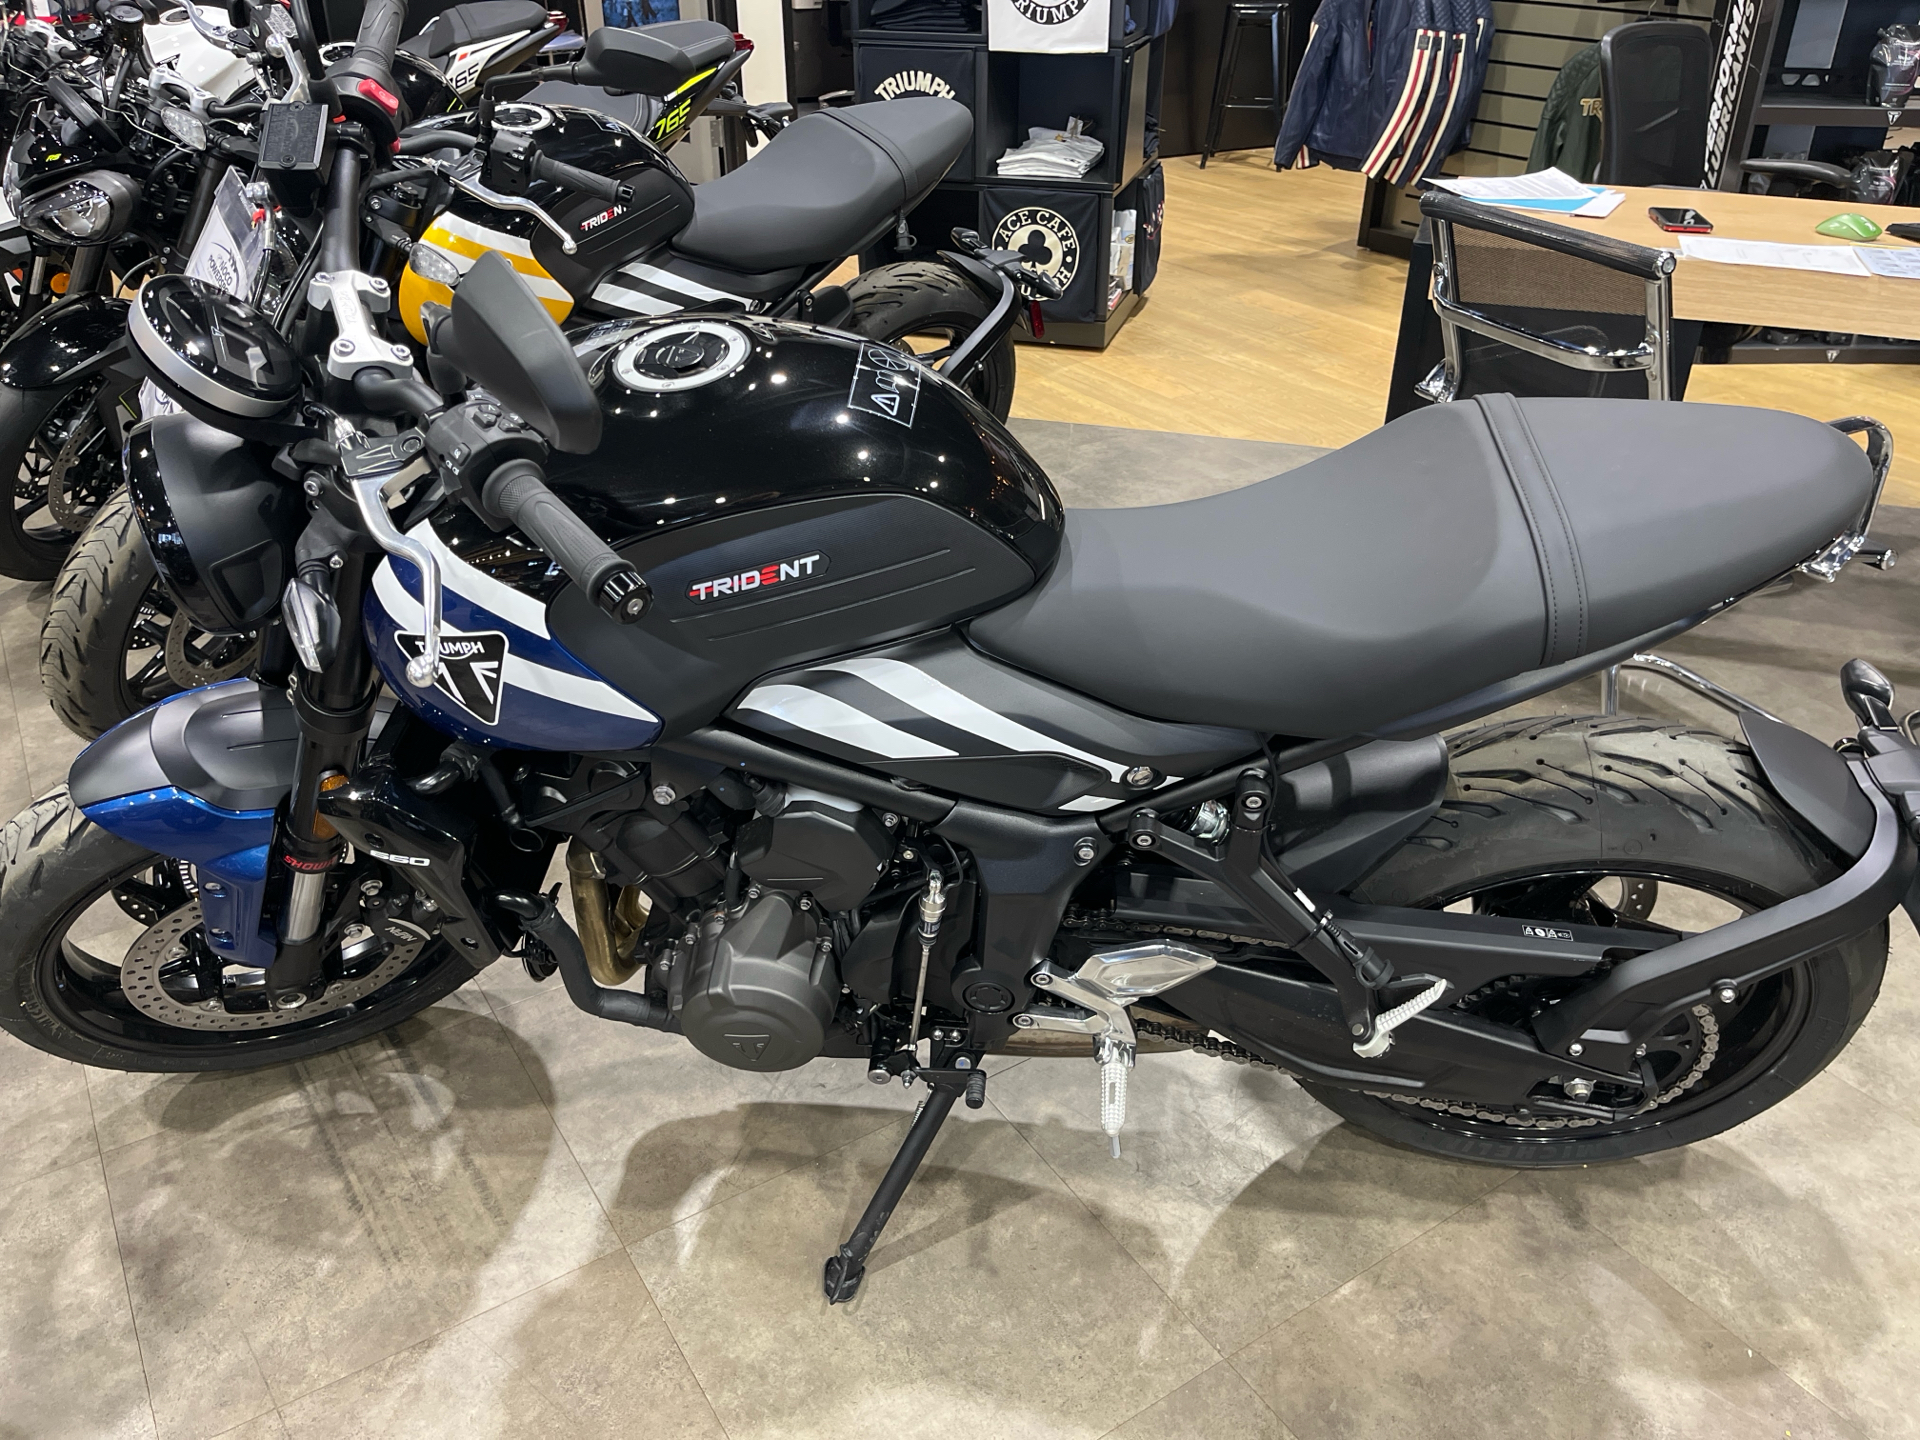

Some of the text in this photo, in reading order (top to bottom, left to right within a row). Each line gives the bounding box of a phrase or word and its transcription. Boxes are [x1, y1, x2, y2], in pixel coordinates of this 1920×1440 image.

[1014, 0, 1087, 24] RIUMP
[874, 70, 956, 101] TRIUMPH
[1707, 2, 1755, 188] LUBRICANTS
[655, 98, 691, 140] 765
[1579, 97, 1604, 121] TR
[998, 211, 1076, 252] ACE CAFE
[690, 554, 820, 601] TRIDENT
[415, 641, 485, 656] TUMPH
